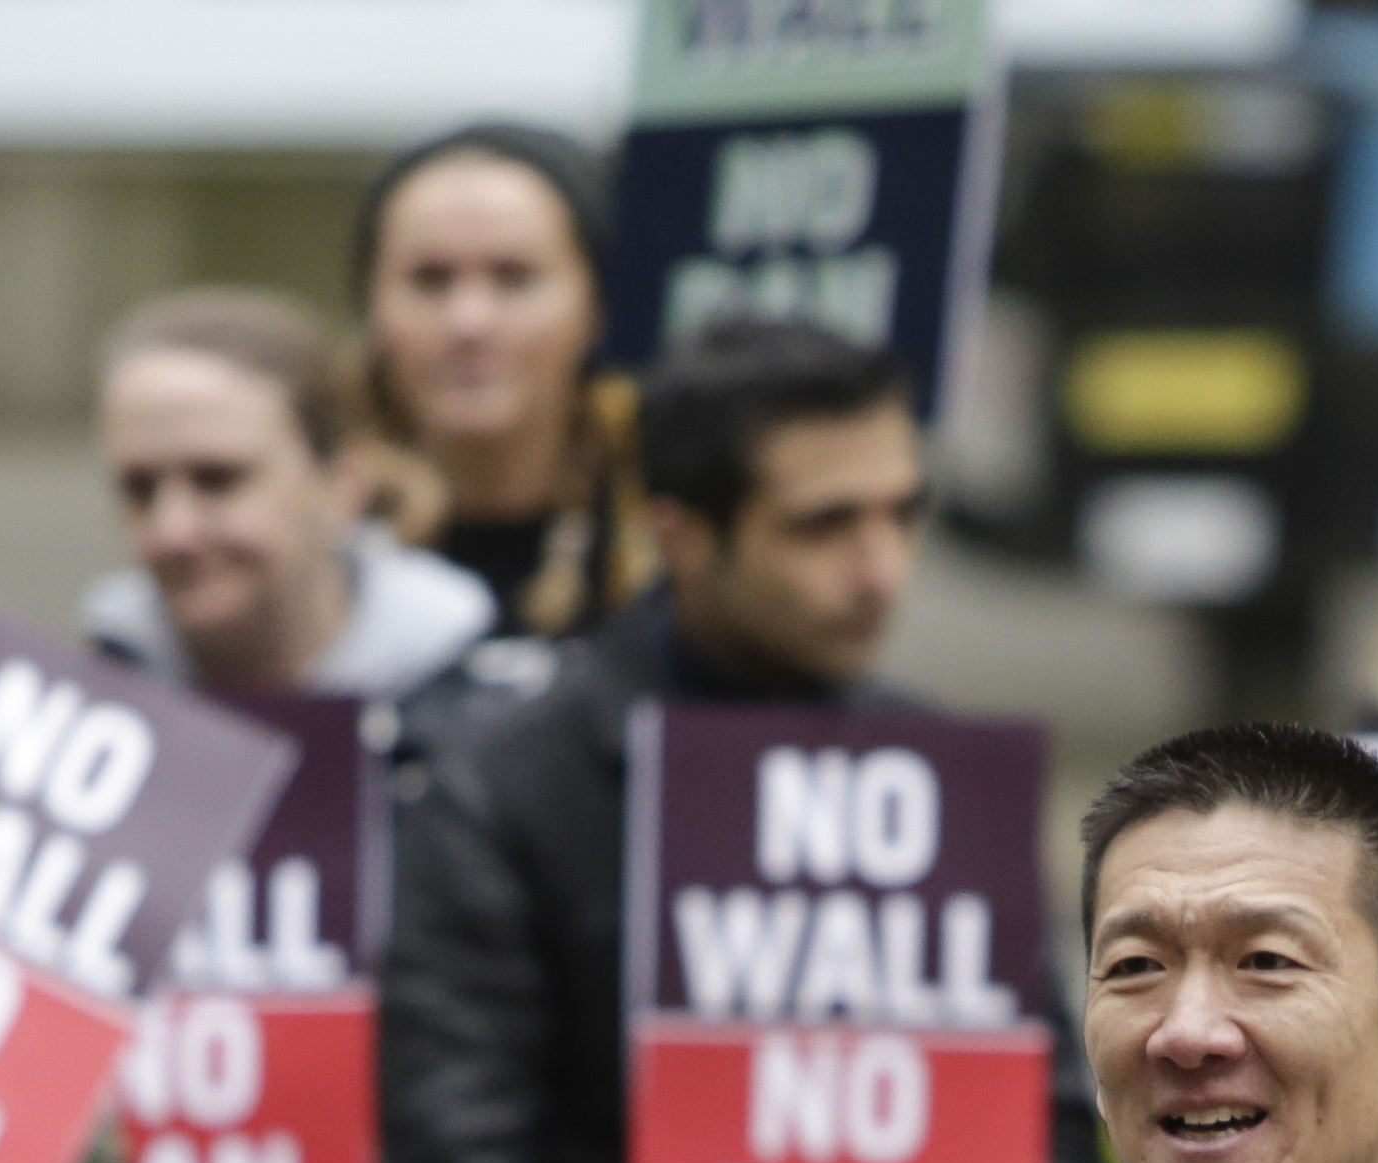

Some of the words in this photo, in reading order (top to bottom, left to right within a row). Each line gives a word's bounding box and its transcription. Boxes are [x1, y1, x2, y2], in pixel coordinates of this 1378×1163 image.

[712, 127, 878, 250] NO
[755, 746, 940, 887] NO
[169, 858, 350, 990] LL
[674, 888, 1019, 1028] WALL
